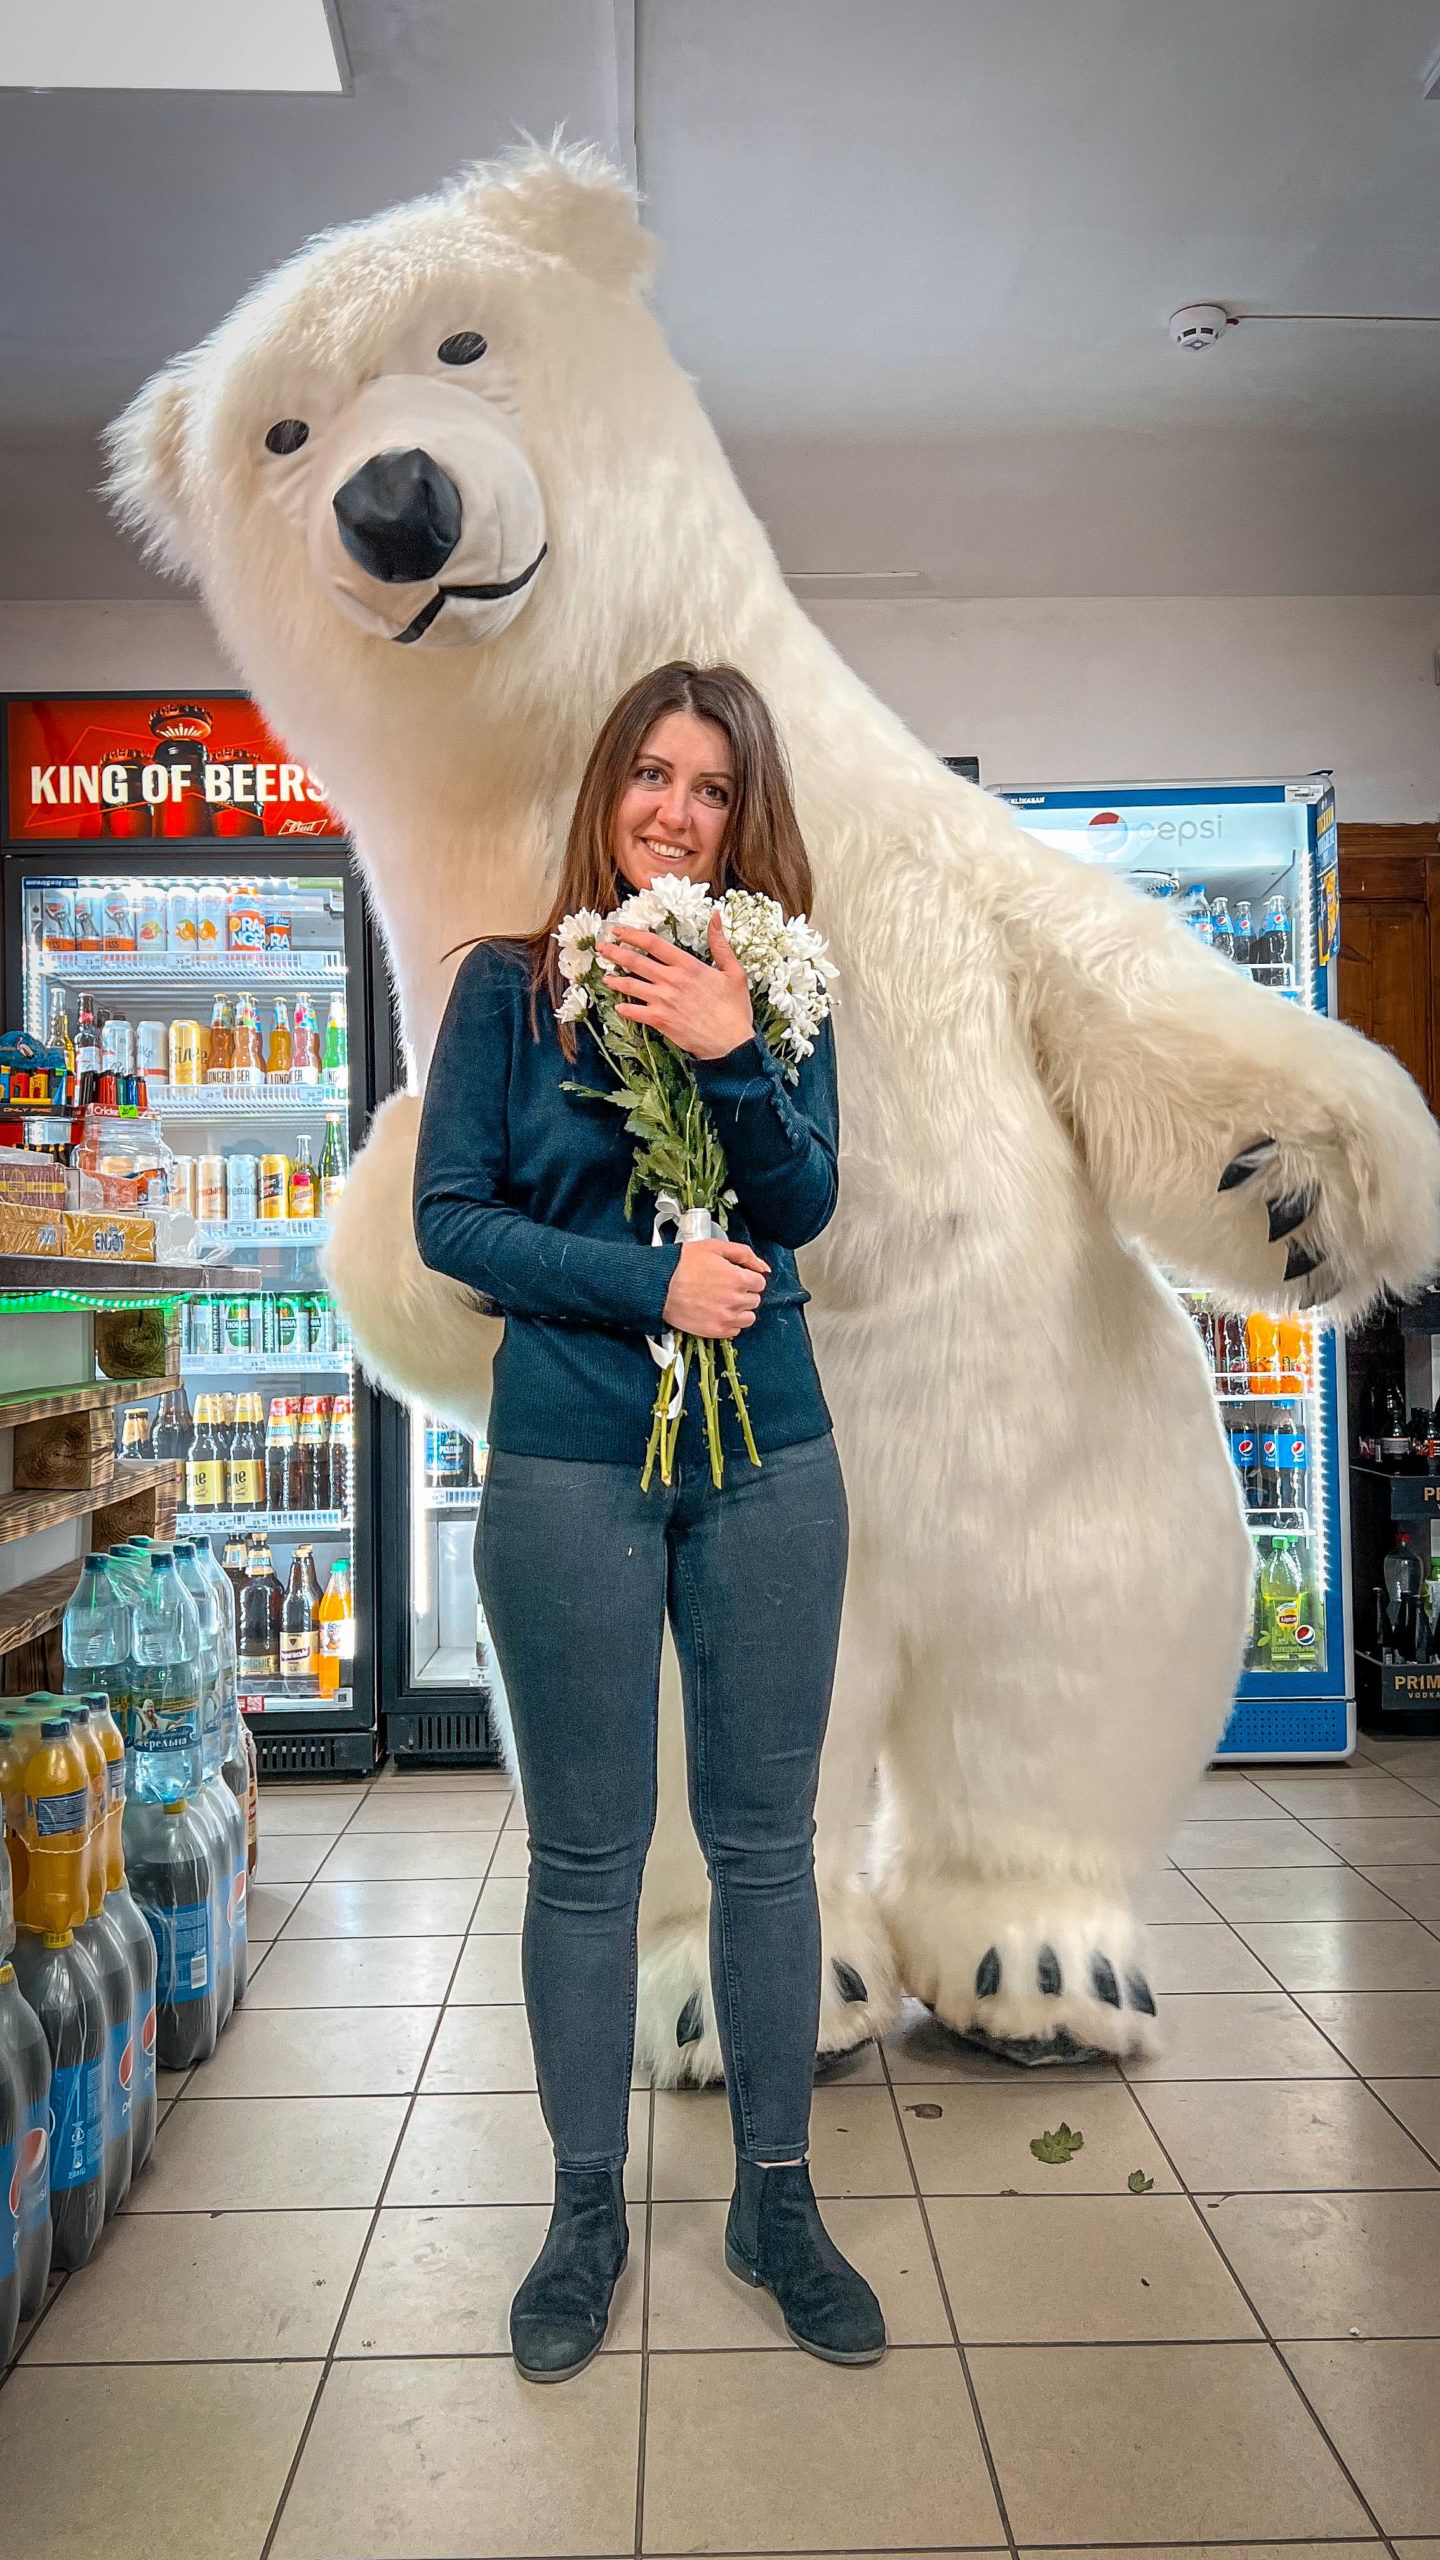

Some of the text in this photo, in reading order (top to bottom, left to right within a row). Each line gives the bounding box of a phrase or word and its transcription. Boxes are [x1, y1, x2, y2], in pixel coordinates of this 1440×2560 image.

[31, 763, 329, 804] KING OF BEERS
[287, 820, 315, 833] Bud
[93, 1105, 119, 1115] Cricke
[94, 1231, 125, 1252] ENJOY
[1394, 1675, 1440, 1690] PRIM
